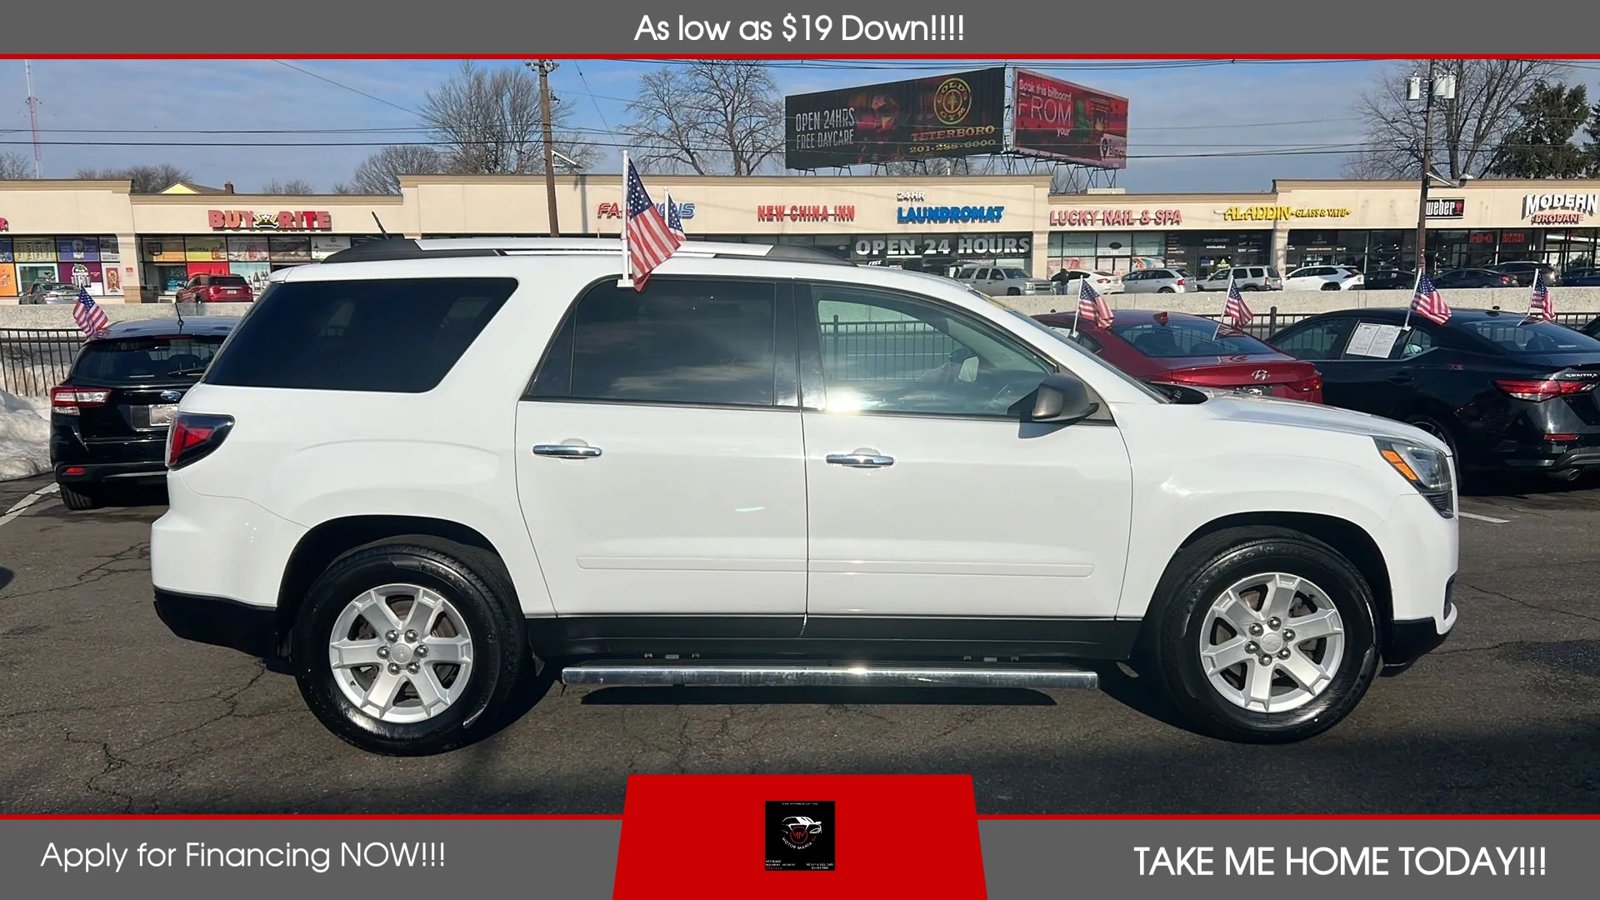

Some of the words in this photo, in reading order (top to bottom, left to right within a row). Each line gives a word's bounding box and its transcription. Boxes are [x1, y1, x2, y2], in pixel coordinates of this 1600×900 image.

[1018, 92, 1072, 126] FROM
[795, 111, 820, 132] OPEN
[823, 107, 855, 129] 24HRS
[796, 133, 816, 149] FREE
[817, 129, 854, 148] DAYCARE
[911, 125, 995, 142] TETERBORO
[757, 205, 785, 222] NEW
[789, 205, 829, 222] CHINA
[833, 205, 855, 222] INN
[897, 205, 1005, 225] LAUNDROMAT
[1223, 205, 1292, 221] ALADDIN
[1426, 199, 1456, 216] weber
[1522, 193, 1598, 219] MODERN
[208, 209, 254, 230] BUY
[277, 210, 332, 232] RITE
[1049, 209, 1099, 227] LUCKY
[1101, 209, 1136, 226] NAIL
[1141, 209, 1151, 226] &
[1153, 208, 1183, 225] SPA
[855, 238, 917, 256] OPEN
[923, 238, 951, 255] 24
[958, 237, 1030, 255] HOURS
